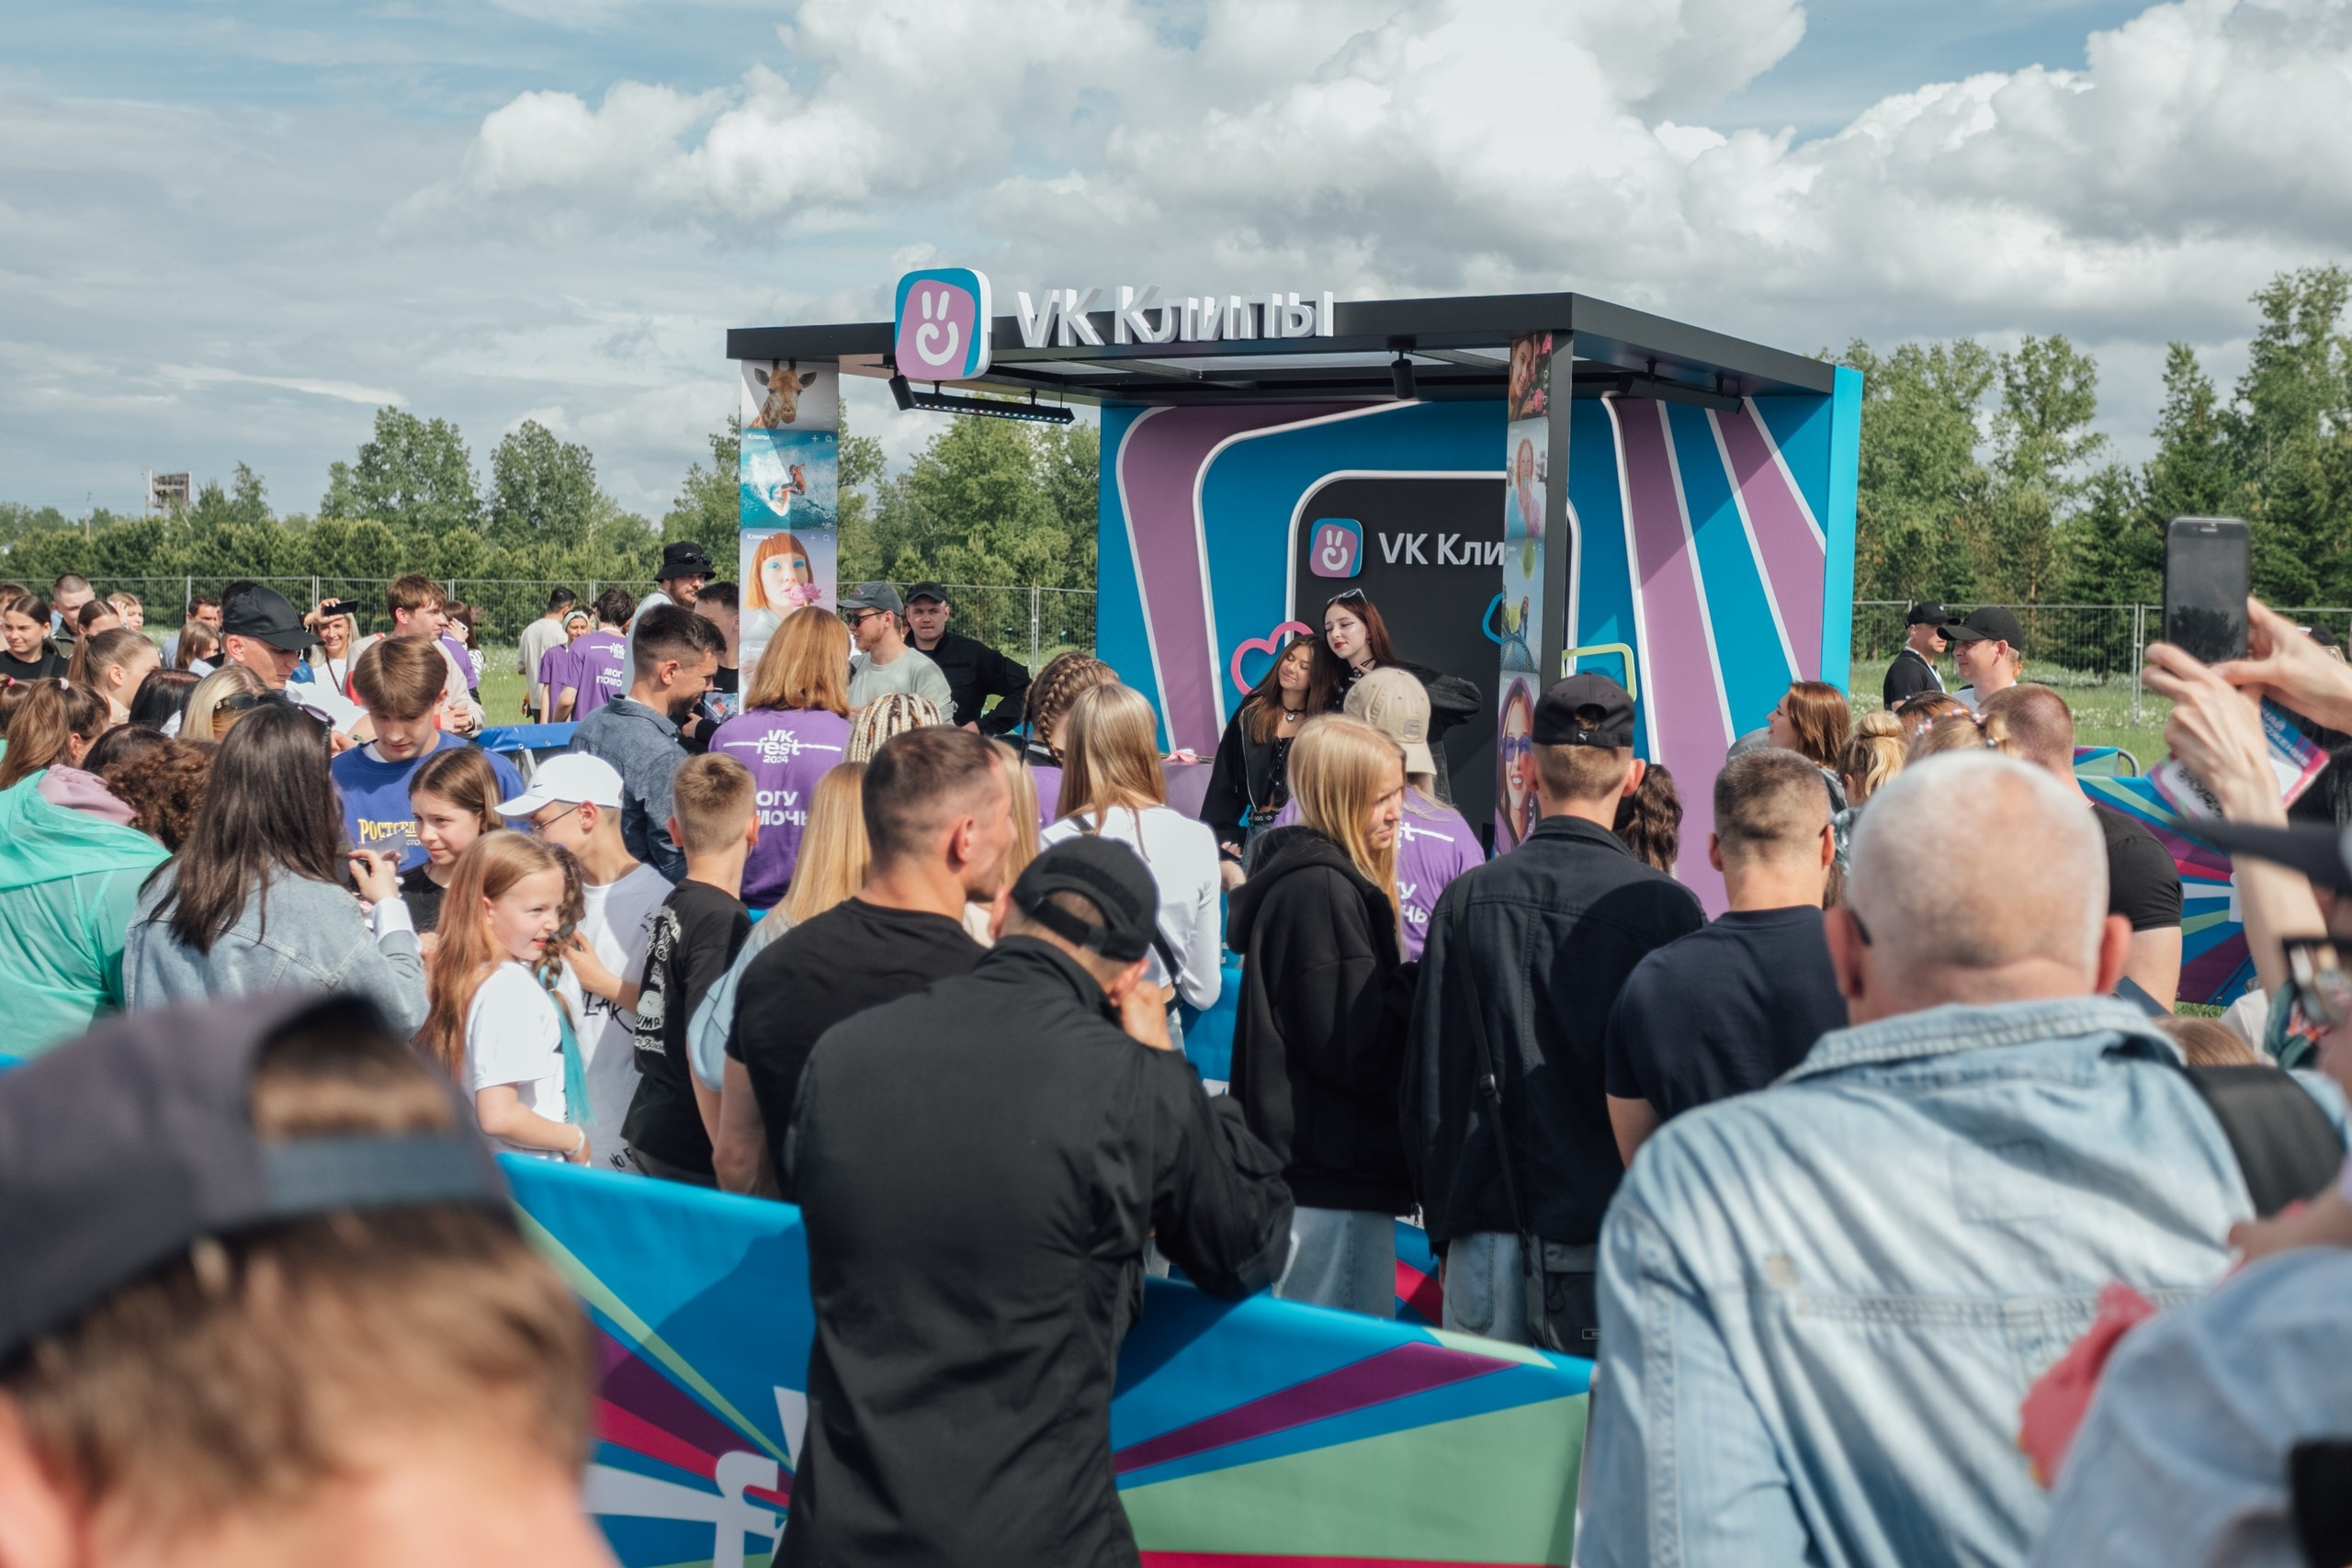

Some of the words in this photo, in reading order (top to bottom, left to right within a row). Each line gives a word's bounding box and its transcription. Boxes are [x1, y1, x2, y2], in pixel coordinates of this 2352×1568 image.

[1016, 287, 1105, 348] VK
[1114, 284, 1334, 344] Клипы
[1378, 533, 1429, 565] VK
[1438, 533, 1505, 566] Кли
[595, 675, 623, 687] ПОМО
[604, 667, 624, 679] МОГ
[768, 729, 796, 743] VK
[756, 737, 801, 756] fest
[2263, 724, 2312, 768] ОЖЕНИЕ
[763, 754, 789, 764] 2024
[755, 790, 798, 807] ОГУ
